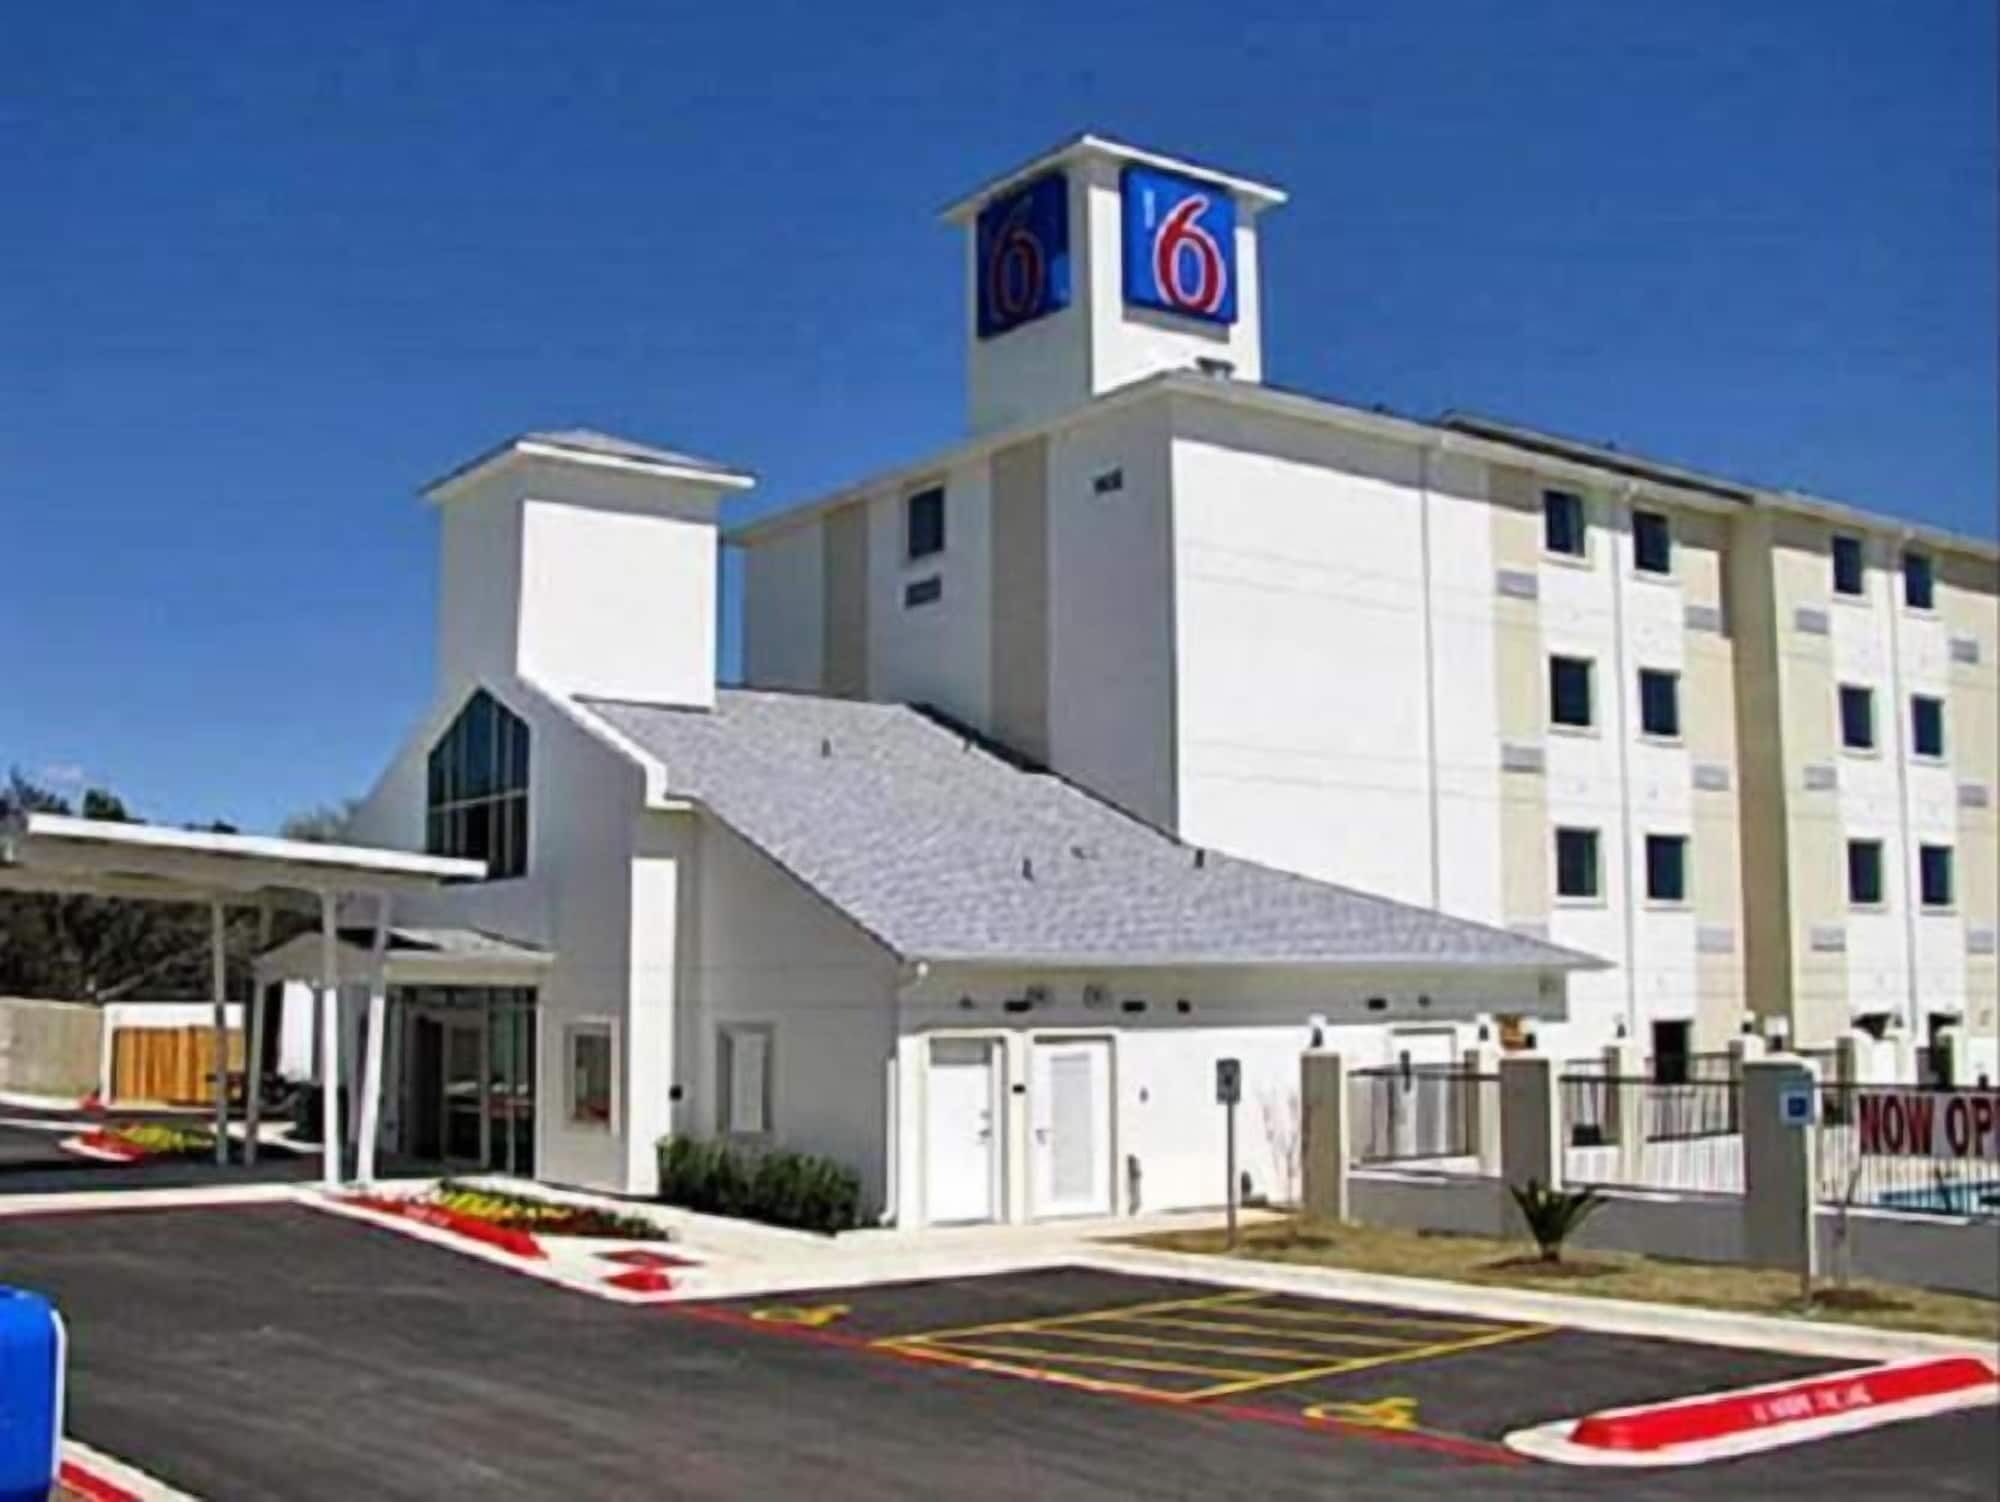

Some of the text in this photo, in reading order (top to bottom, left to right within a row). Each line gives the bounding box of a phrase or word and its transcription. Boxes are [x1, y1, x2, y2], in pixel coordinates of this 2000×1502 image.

[988, 195, 1045, 324] 6
[1153, 194, 1227, 313] 6
[1859, 1094, 1935, 1155] NOW
